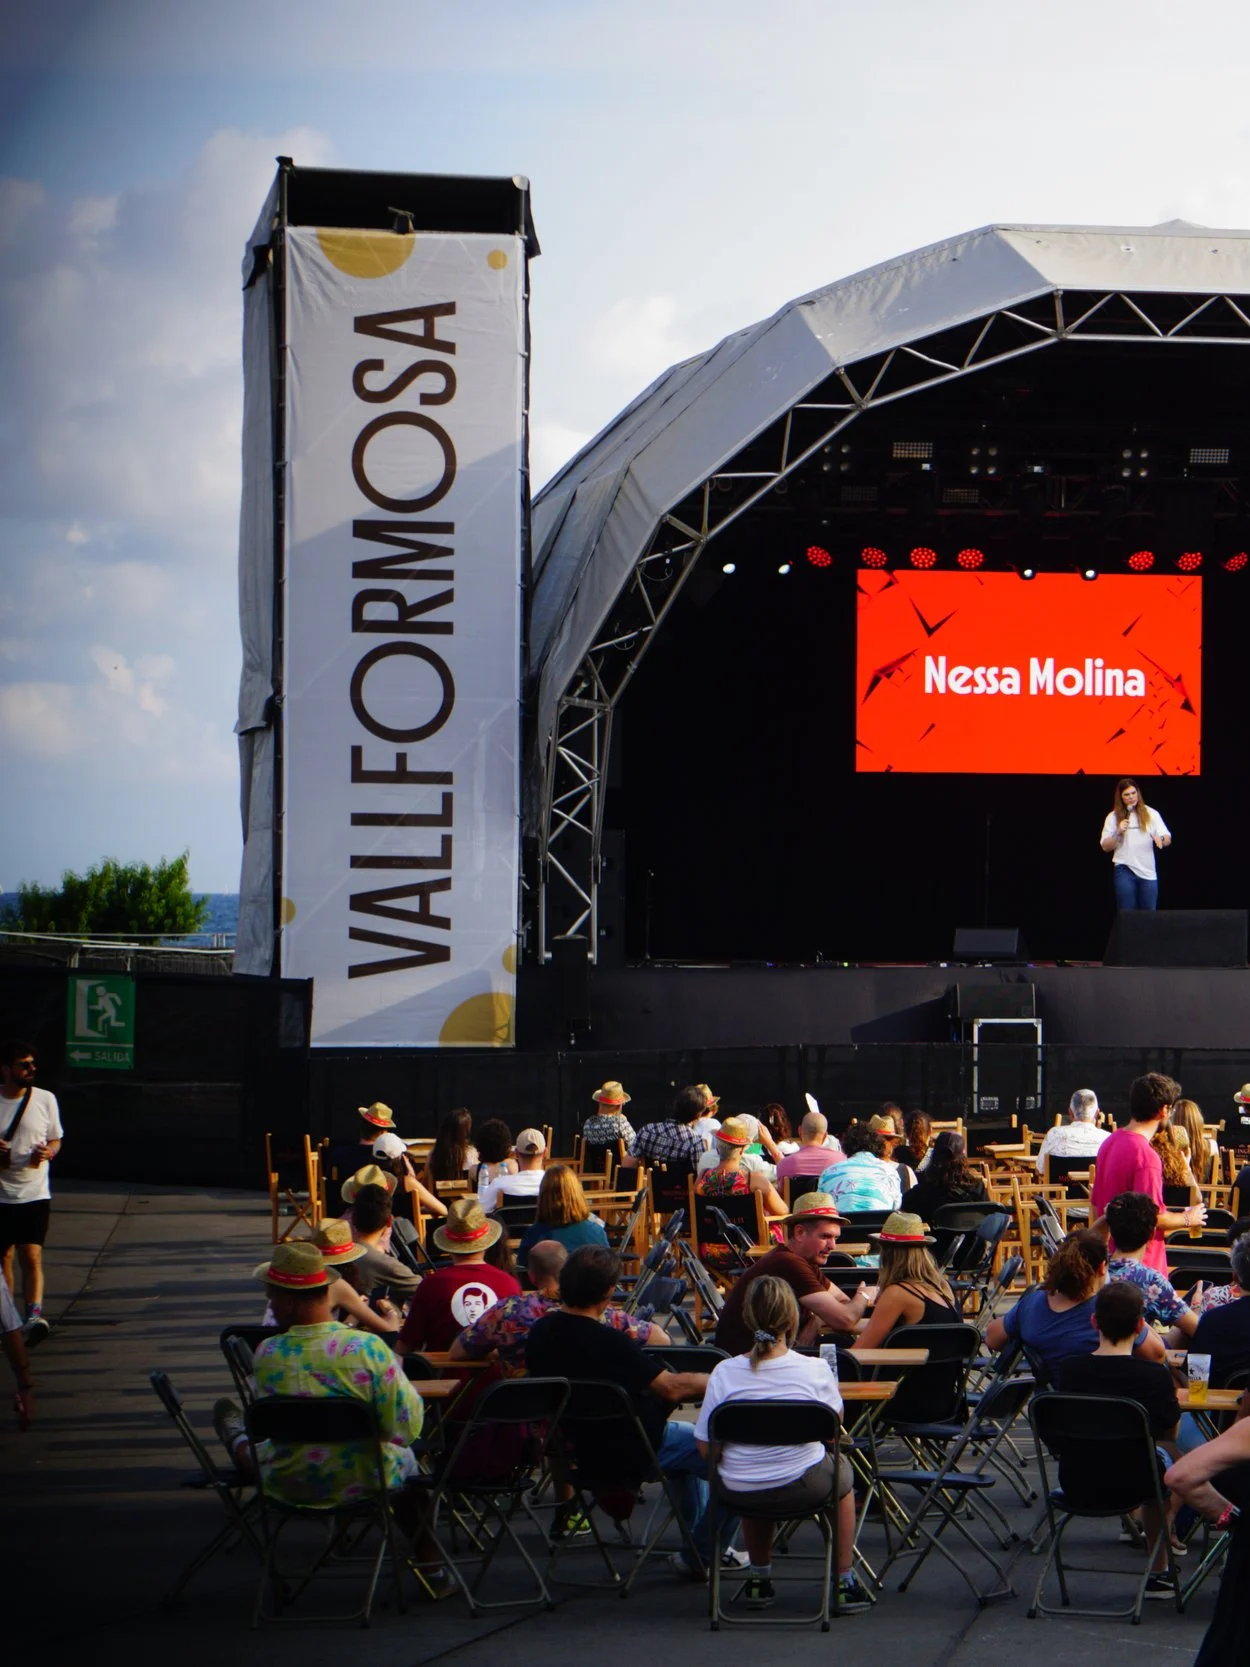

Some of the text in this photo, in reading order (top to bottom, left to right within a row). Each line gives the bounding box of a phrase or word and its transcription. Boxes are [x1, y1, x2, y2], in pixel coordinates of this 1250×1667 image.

[347, 300, 457, 980] VALLFORMOSA
[924, 655, 1146, 698] Nessa Molina
[94, 1050, 130, 1062] SALIDA
